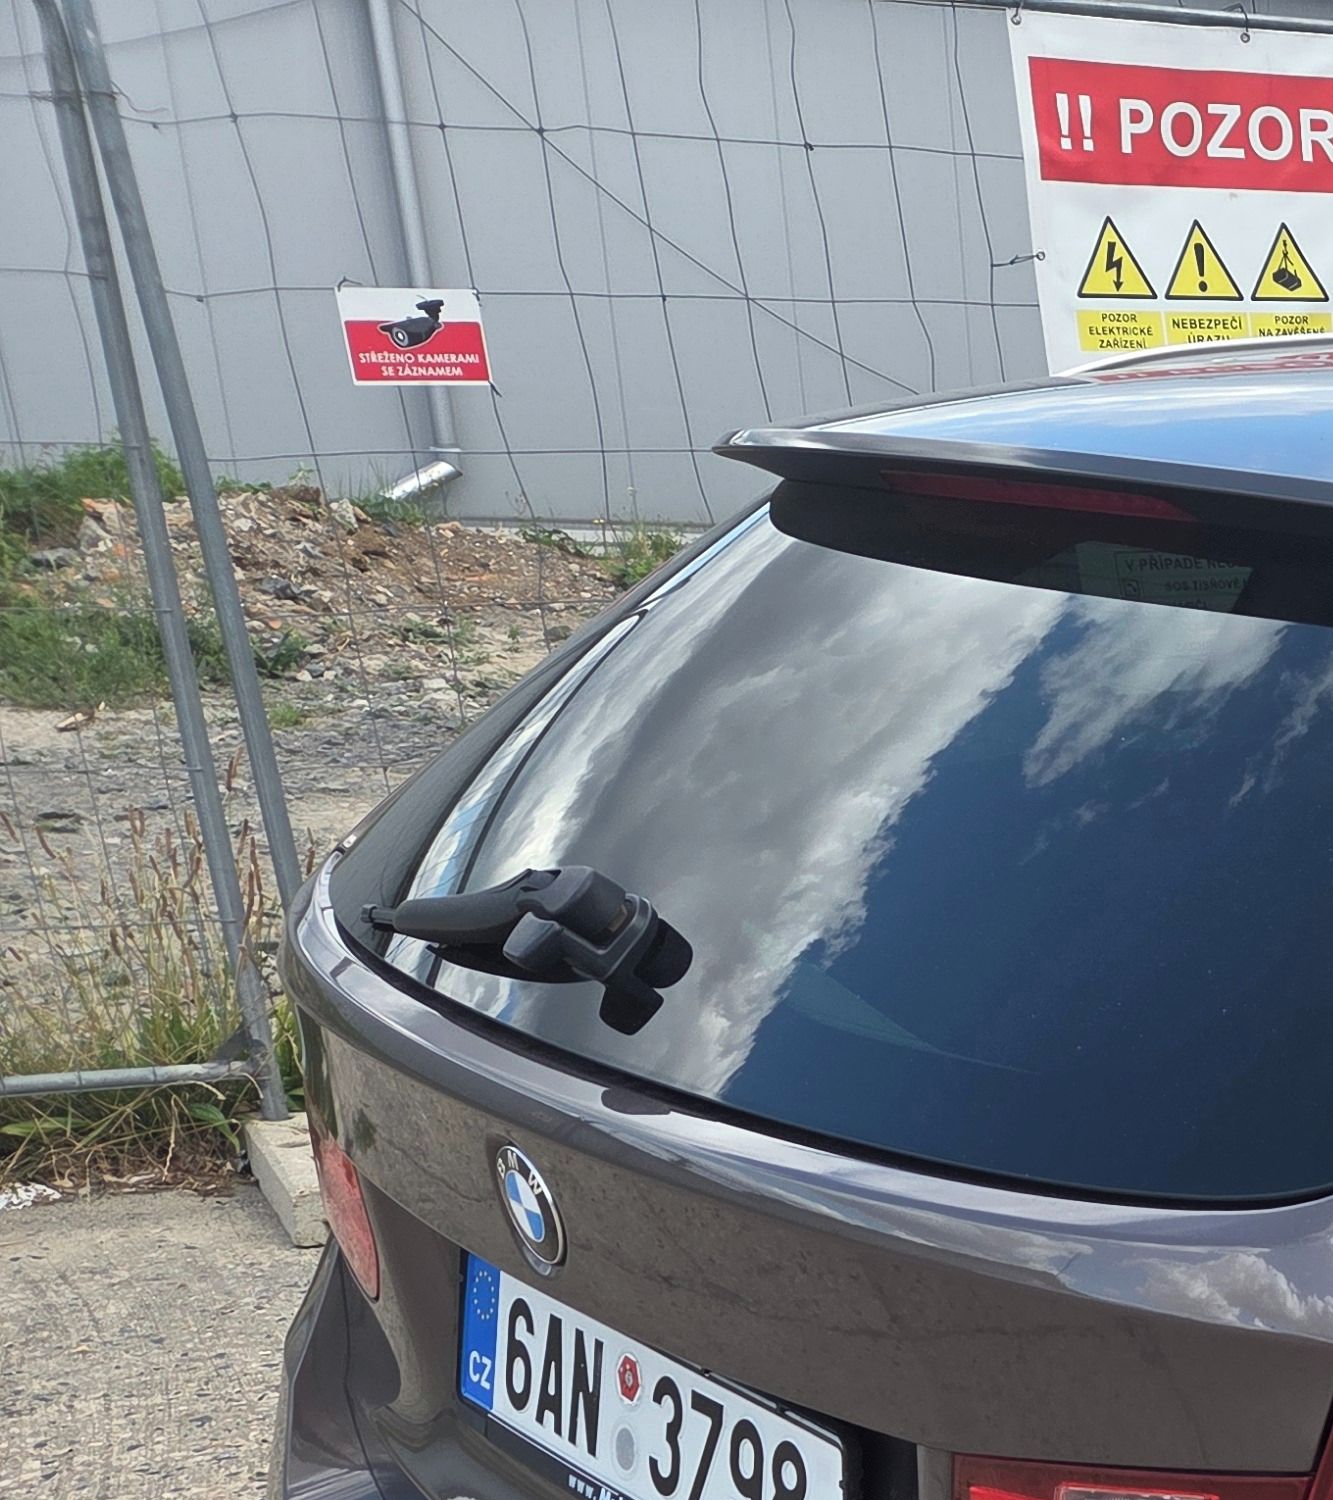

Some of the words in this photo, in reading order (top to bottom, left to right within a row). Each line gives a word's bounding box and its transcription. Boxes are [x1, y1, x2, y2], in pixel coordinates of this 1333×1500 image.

[1055, 93, 1095, 152] !!
[1101, 312, 1138, 323] POZOR
[1171, 315, 1243, 330] NEBEZPEČÍ
[1274, 315, 1309, 325] POZOR
[1088, 325, 1154, 336] ELEKTRICKÉ
[1098, 336, 1147, 349] ZAŘÍZENÍ
[358, 350, 415, 364] STŘEŽENO
[417, 353, 480, 364] KAMERAMI
[381, 366, 395, 377] SE
[398, 363, 463, 377] ZÁZNAMEM
[497, 1149, 543, 1195] BMW
[469, 1350, 492, 1391] CZ
[506, 1297, 604, 1458] 6AN
